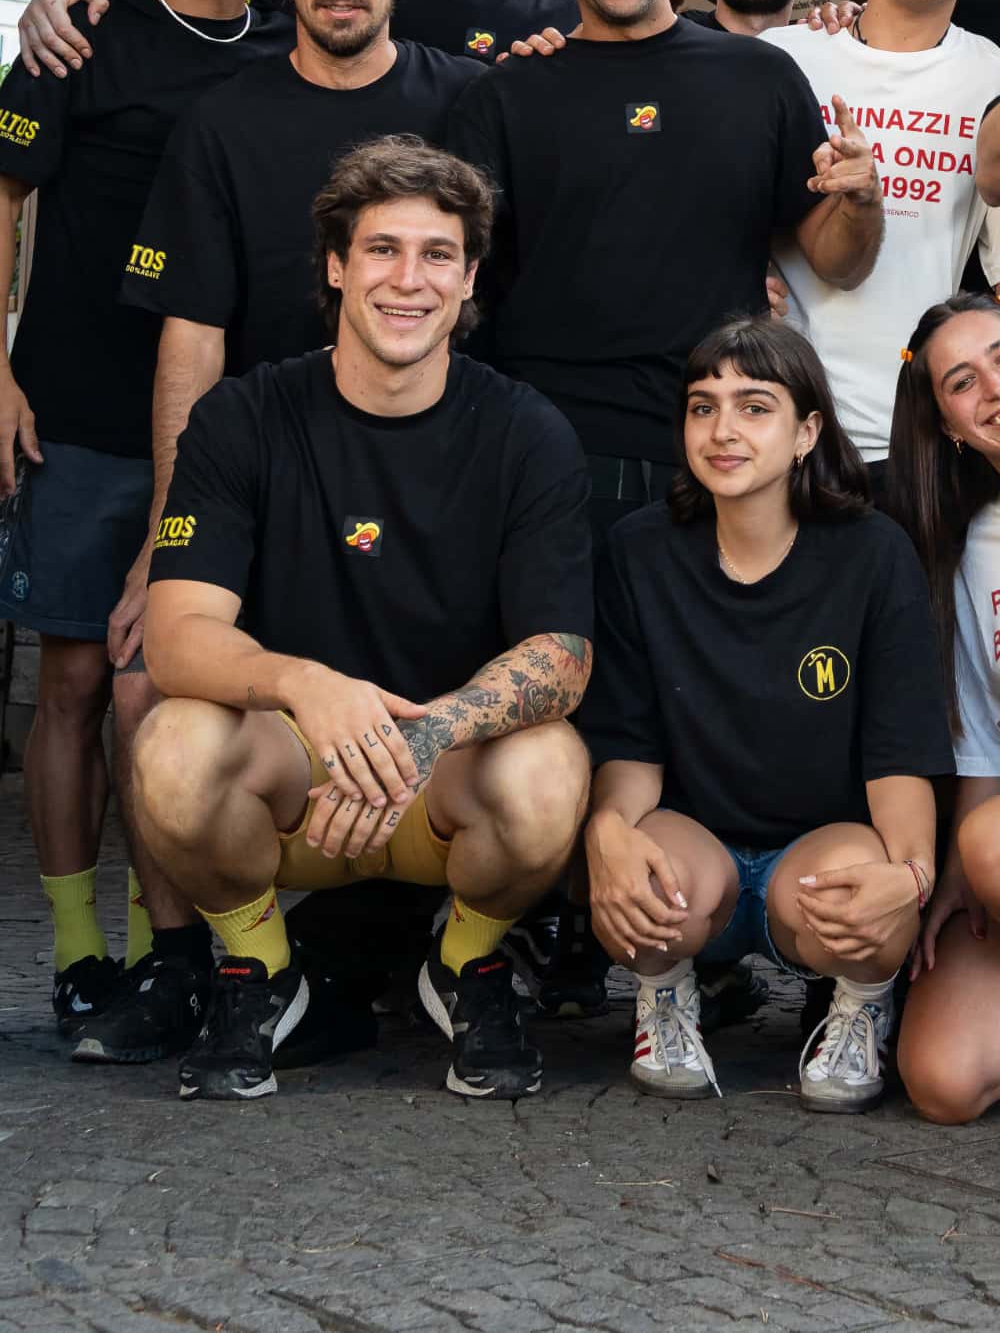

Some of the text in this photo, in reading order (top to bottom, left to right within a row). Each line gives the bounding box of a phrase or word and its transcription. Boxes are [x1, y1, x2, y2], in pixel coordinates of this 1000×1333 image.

[958, 117, 976, 139] E
[894, 147, 973, 175] ONDA
[880, 176, 942, 203] 1992
